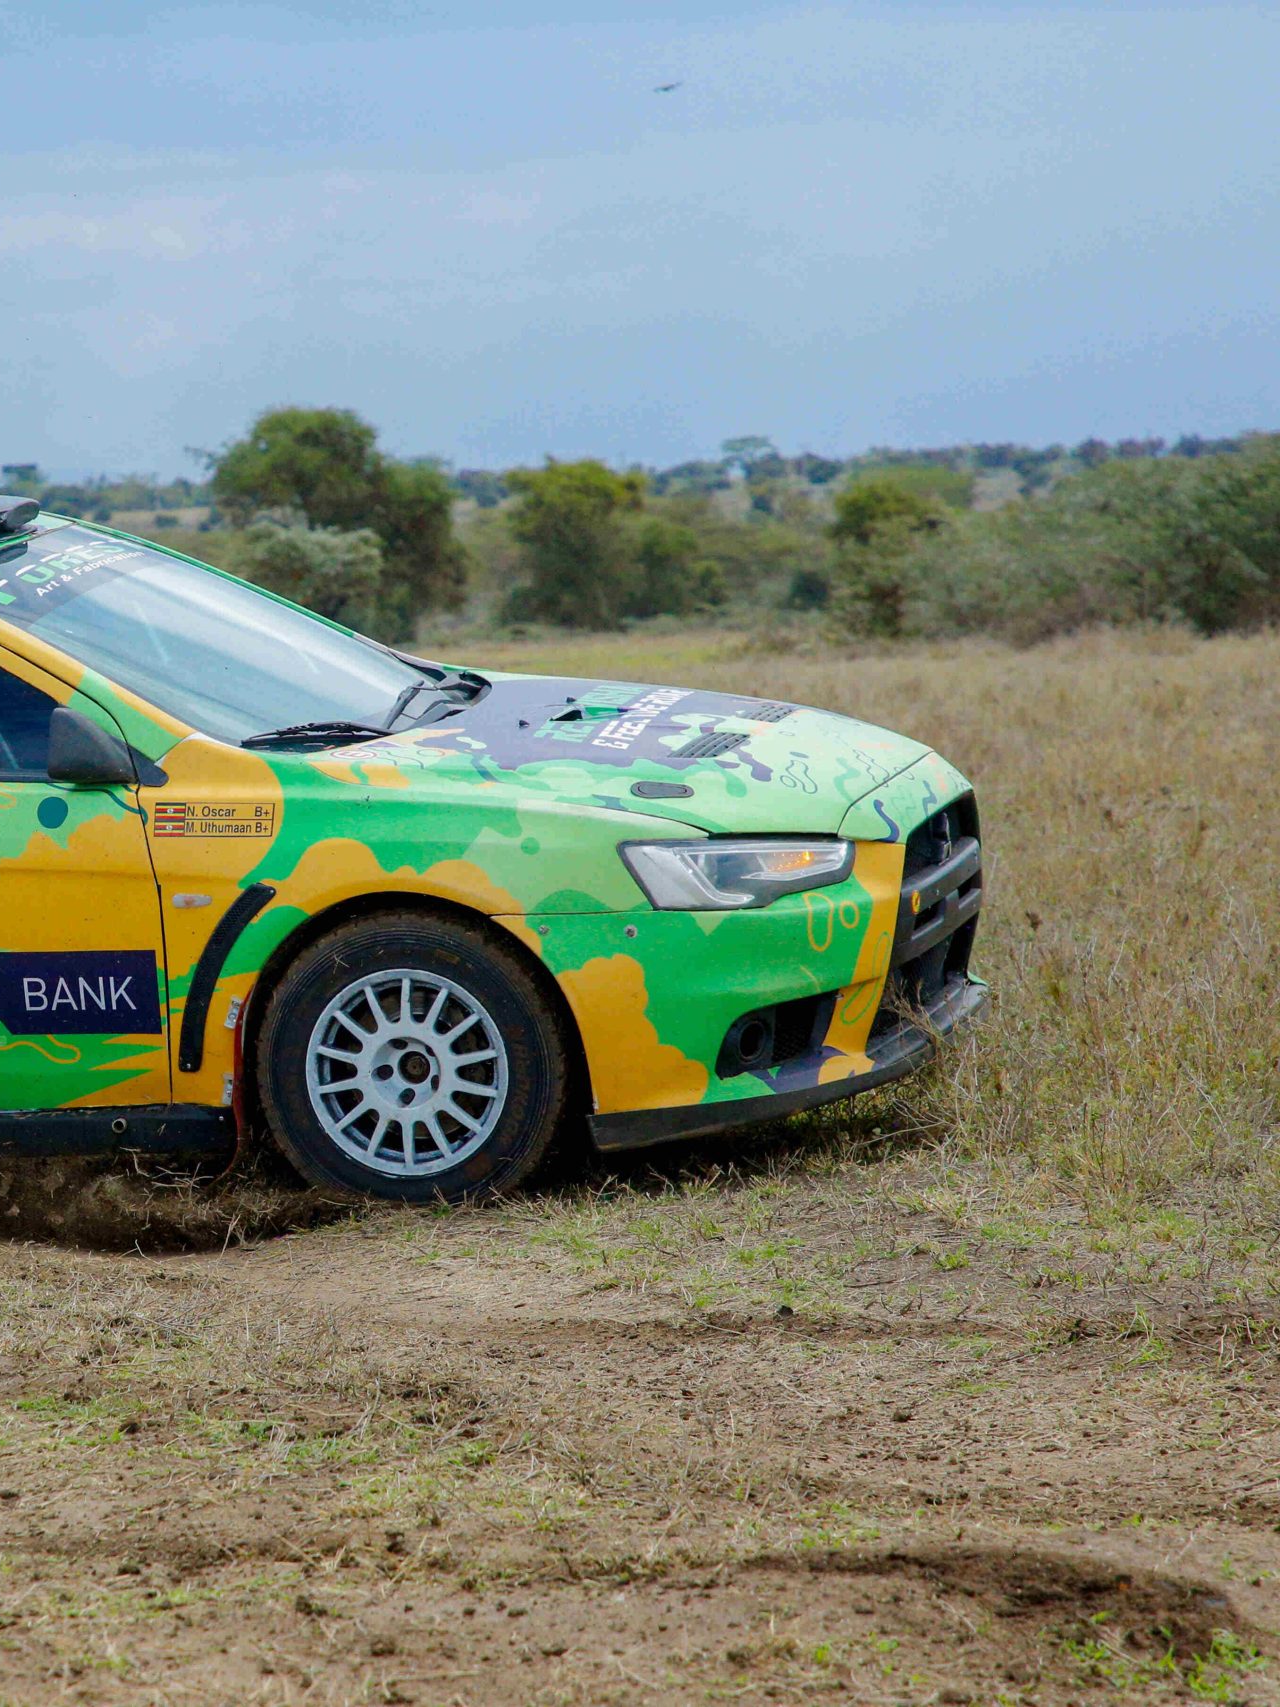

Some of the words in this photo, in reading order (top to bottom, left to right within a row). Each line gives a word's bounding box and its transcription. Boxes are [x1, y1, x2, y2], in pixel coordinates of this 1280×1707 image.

[36, 580, 60, 597] Art
[60, 573, 73, 583] &
[75, 551, 145, 577] Fabrication
[186, 805, 199, 818] N.
[201, 805, 237, 818] Oscar
[254, 806, 271, 818] B+
[185, 821, 198, 833] M.
[200, 821, 253, 834] Uthumaan
[254, 821, 270, 834] B+
[23, 975, 137, 1012] BANK
